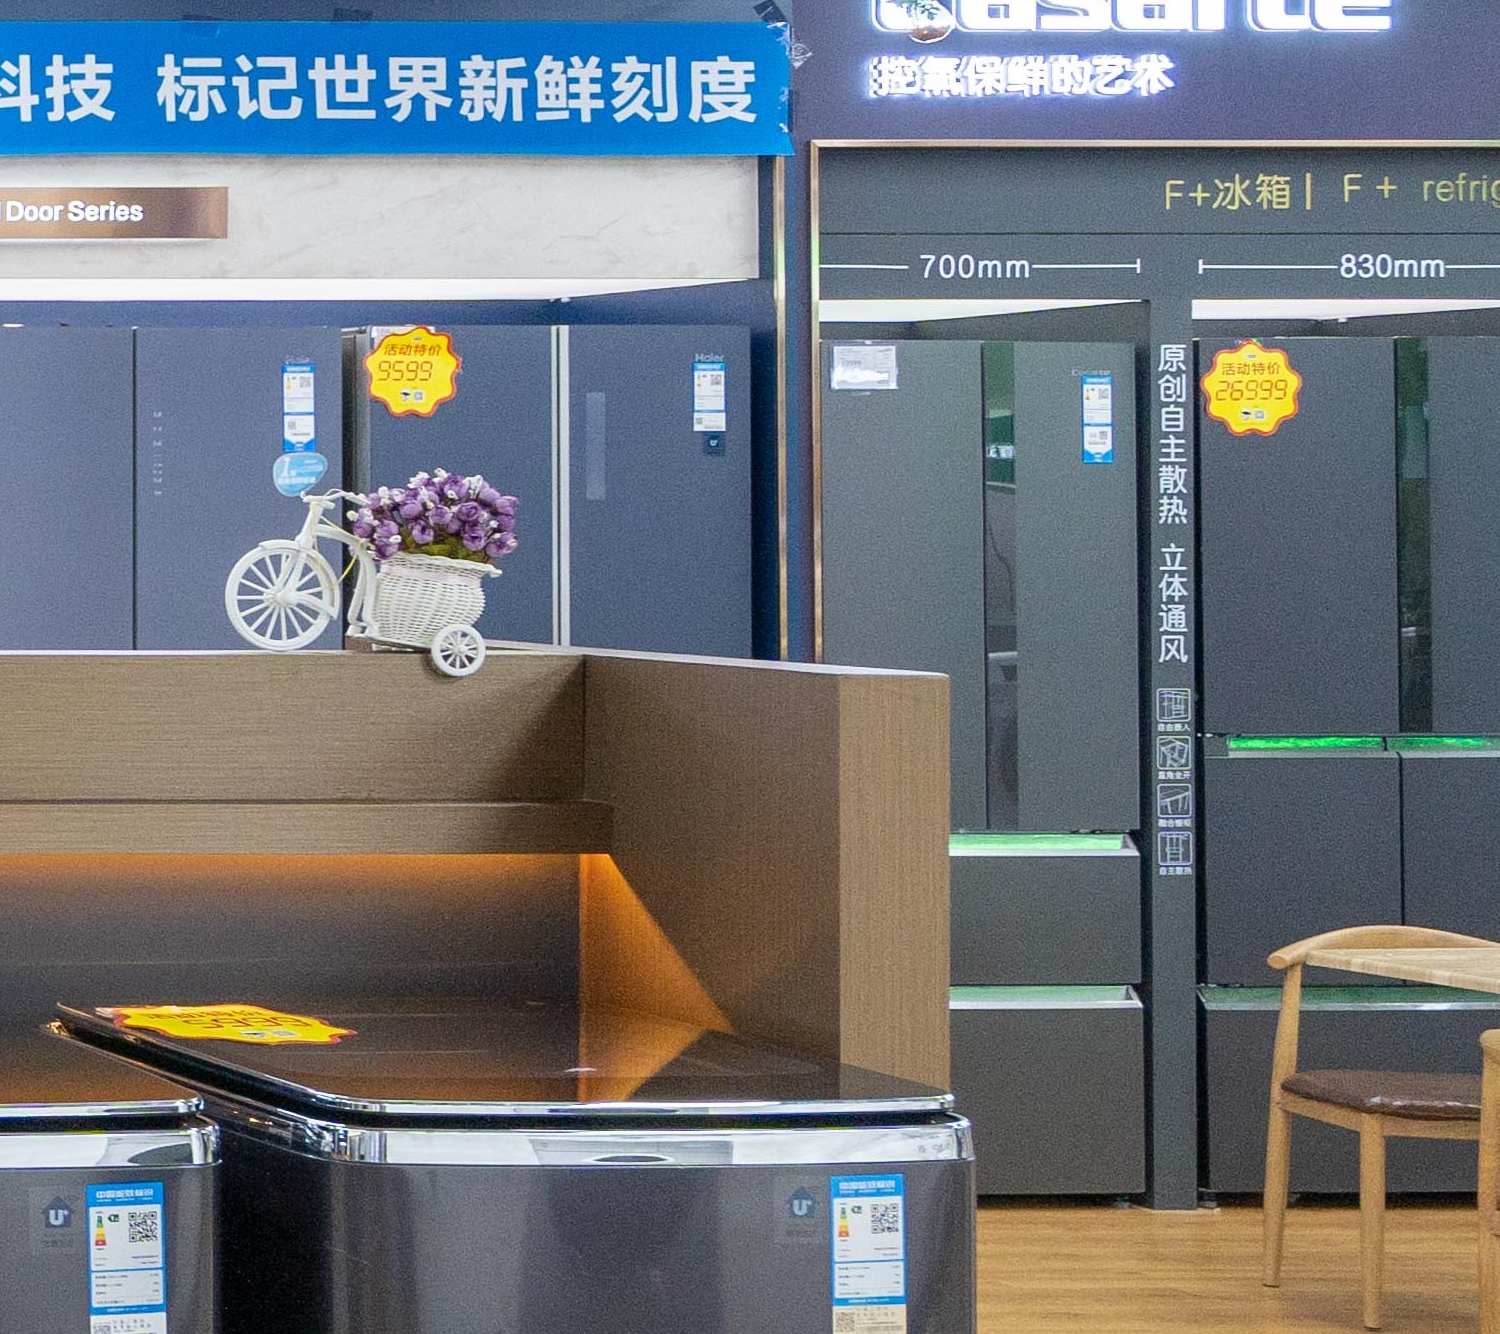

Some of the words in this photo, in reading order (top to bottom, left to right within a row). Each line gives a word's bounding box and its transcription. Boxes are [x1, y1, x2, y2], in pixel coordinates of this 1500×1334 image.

[156, 53, 757, 126] 标记世界新鲜刻度
[6, 200, 64, 224] Door
[68, 200, 143, 224] Series
[920, 254, 1030, 279] 700mm
[1340, 253, 1445, 279] 830mm
[384, 344, 442, 358] 活动特价
[695, 353, 724, 362] Haier
[377, 360, 434, 382] 9599
[1221, 361, 1281, 376] 活动特价
[1216, 380, 1288, 400] 26999
[1158, 343, 1188, 526] 原创自主散热
[1158, 542, 1189, 664] 立体通风
